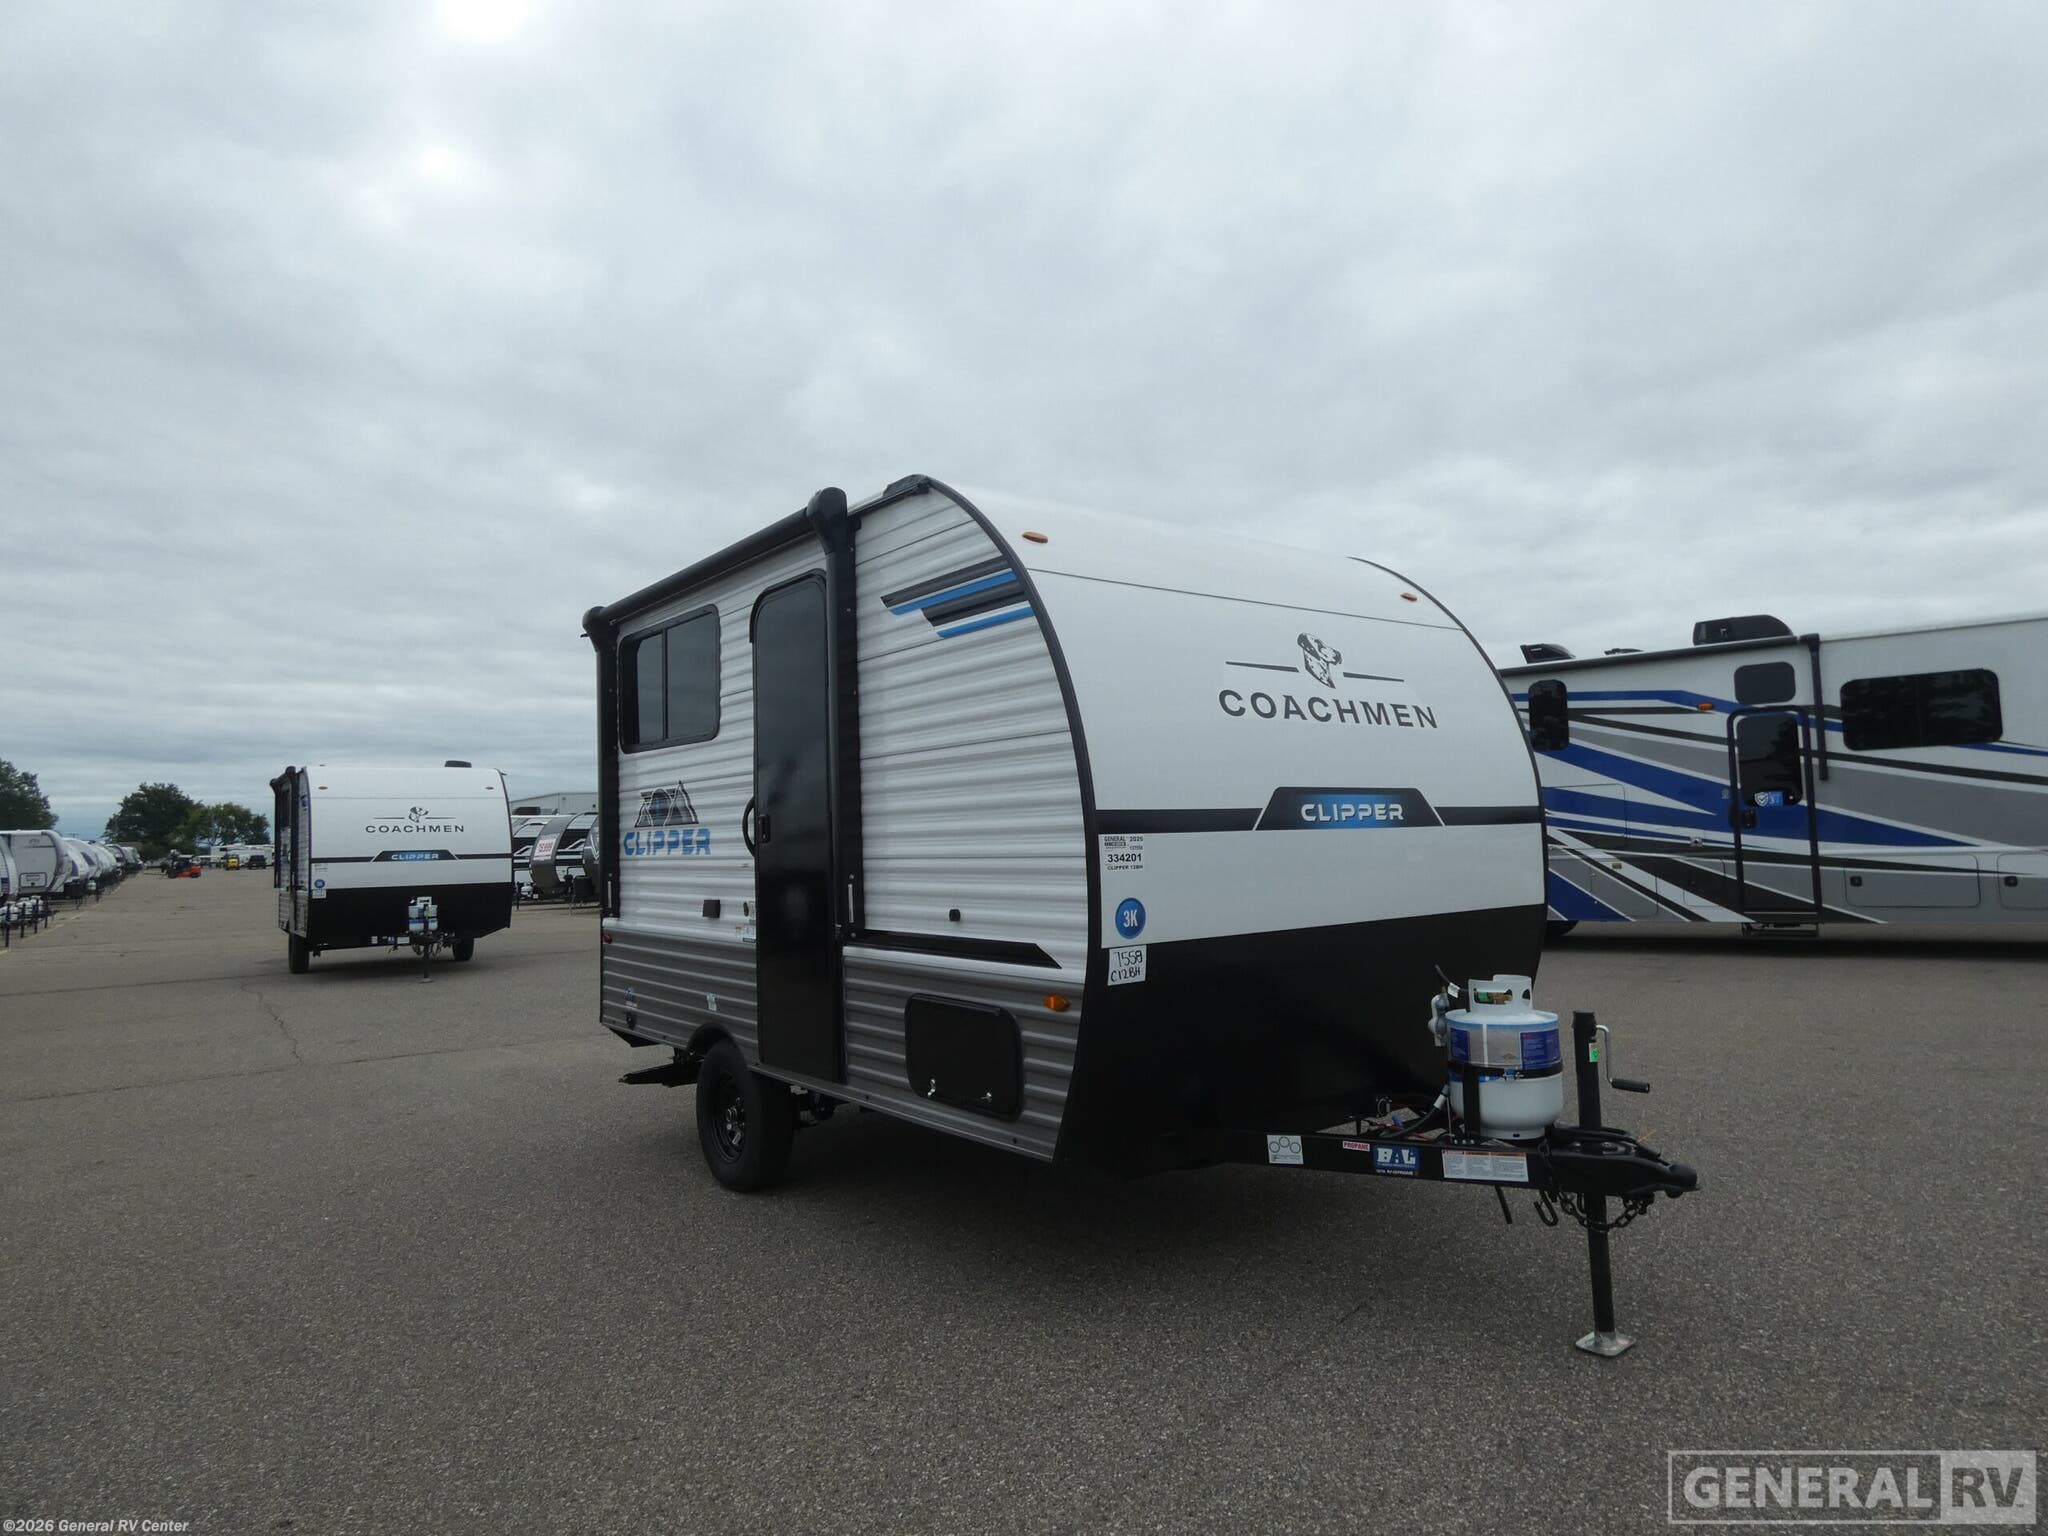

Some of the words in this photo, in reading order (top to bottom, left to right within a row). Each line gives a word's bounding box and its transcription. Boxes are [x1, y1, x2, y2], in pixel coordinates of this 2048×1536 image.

[1218, 689, 1438, 729] COACHMEN
[1300, 803, 1404, 822] CLIPPER
[365, 825, 464, 833] COACHMEN
[623, 828, 711, 856] CLIPPER
[1107, 853, 1142, 863] 334201
[1123, 910, 1138, 928] 3K
[1343, 1142, 1369, 1151] PROPANE
